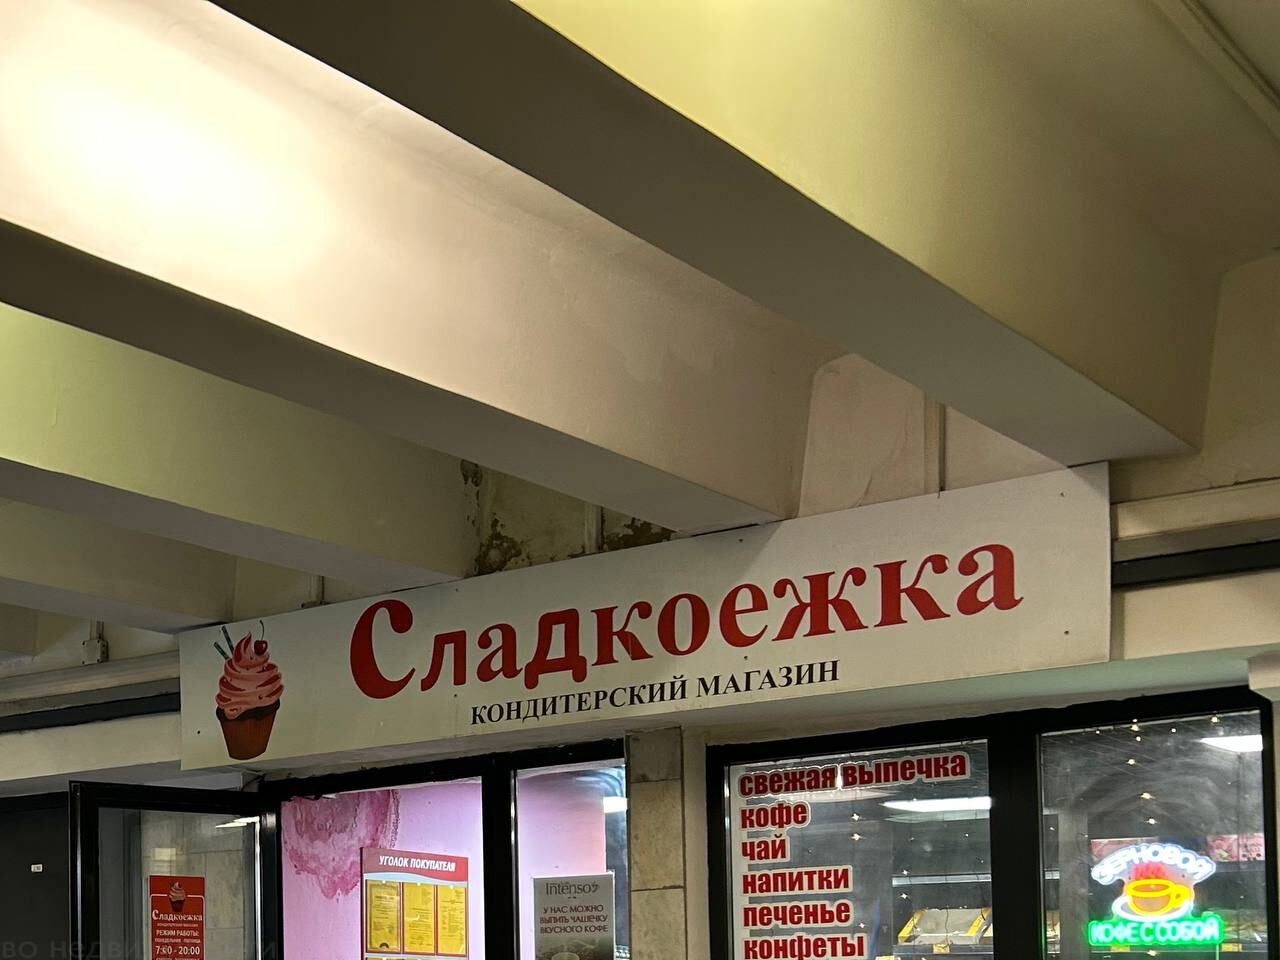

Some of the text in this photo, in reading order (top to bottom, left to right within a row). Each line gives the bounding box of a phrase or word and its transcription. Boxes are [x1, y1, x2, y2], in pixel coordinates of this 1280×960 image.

[350, 542, 1023, 699] Сладкоежка
[471, 659, 840, 726] КОНДИТЕРСКИЙ МАГАЗИН
[739, 754, 967, 796] свежая выпечка
[741, 803, 807, 829] кофе
[741, 834, 786, 861] чай
[379, 855, 456, 872] УГОЛОК ПОКУПАТЕЛЯ
[742, 868, 849, 894] напитки
[152, 909, 203, 922] Сладкоежка
[540, 914, 608, 924] ВЫПИТЬ ЧАШЕЧКУ
[569, 904, 604, 913] МОЖНО
[743, 902, 851, 926] печенье
[156, 929, 176, 937] РЕЖИМ
[540, 925, 583, 934] ВКУСНОГО
[1091, 917, 1220, 943] КОФЕ С СОБОЙ
[178, 946, 201, 955] 20:00
[744, 935, 864, 960] конфеты
